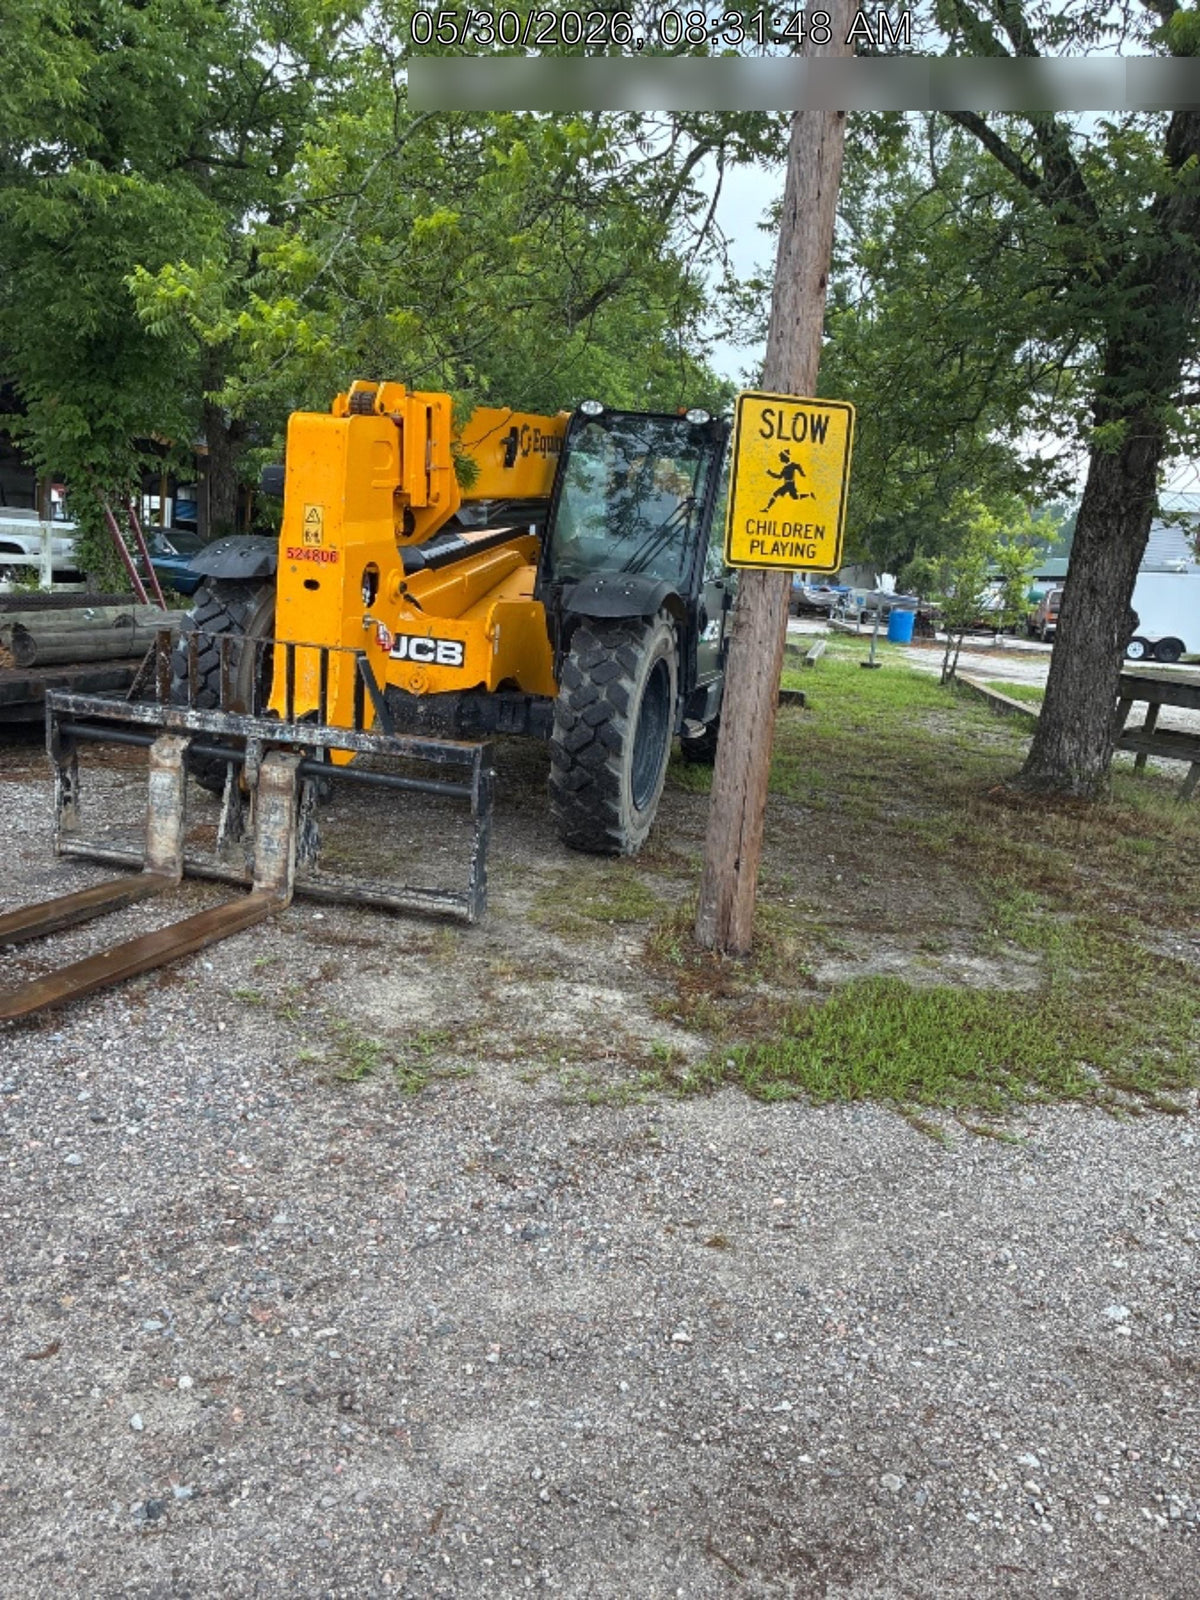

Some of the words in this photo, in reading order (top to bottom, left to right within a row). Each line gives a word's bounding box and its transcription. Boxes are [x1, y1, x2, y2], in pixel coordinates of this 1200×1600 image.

[759, 408, 830, 444] SLOW
[745, 518, 826, 540] CHILDREN
[750, 540, 817, 559] PLAYING
[389, 636, 463, 665] JCB
